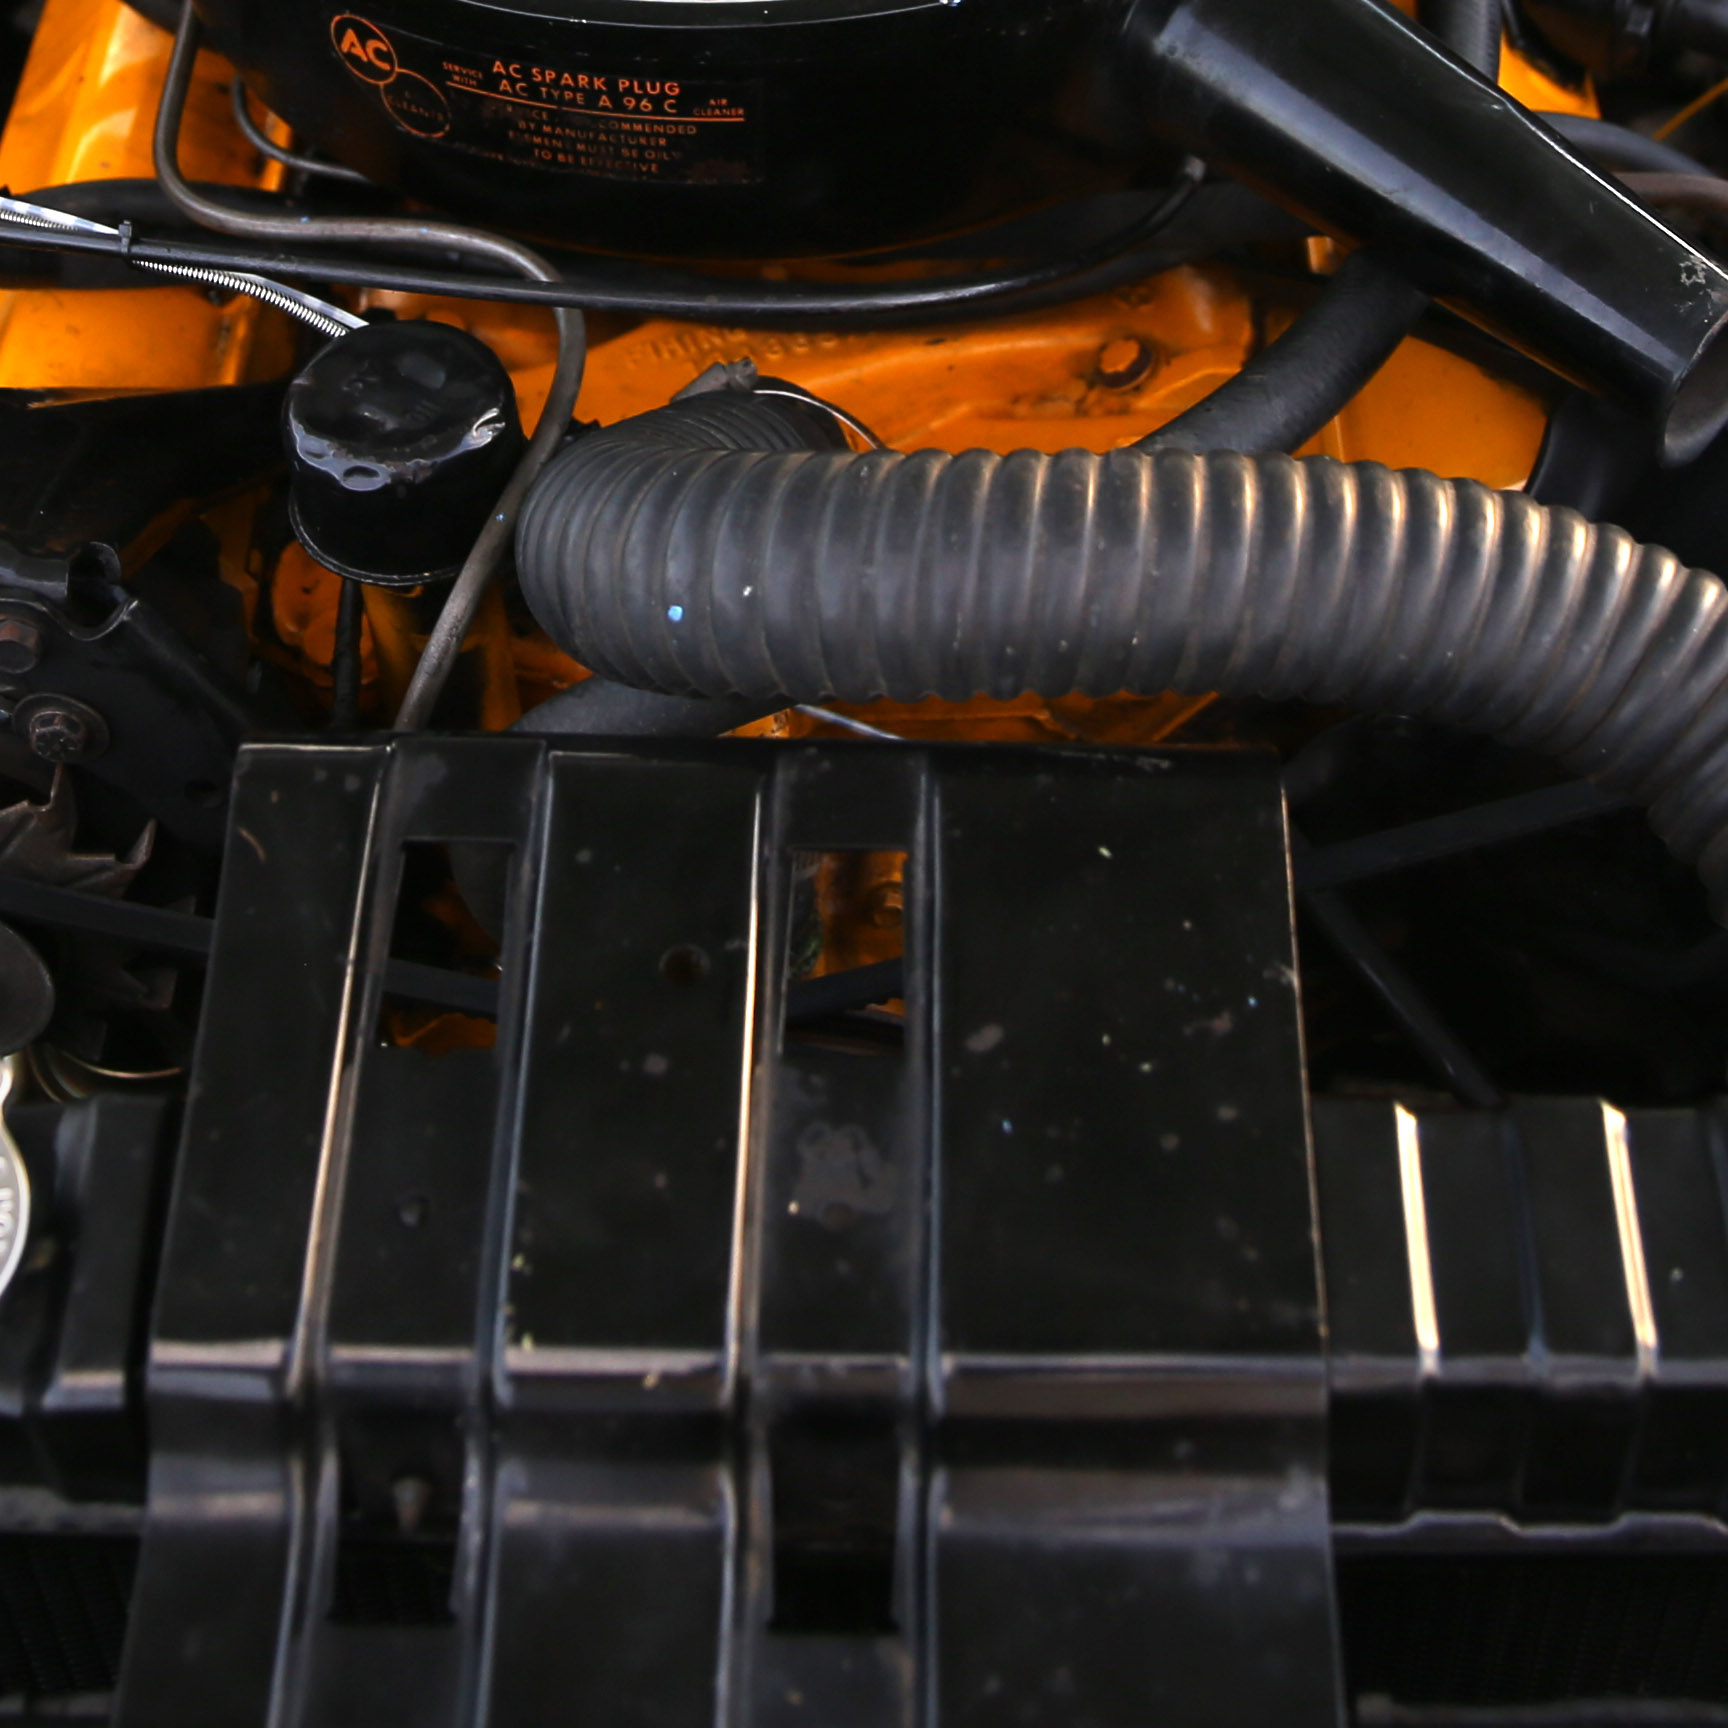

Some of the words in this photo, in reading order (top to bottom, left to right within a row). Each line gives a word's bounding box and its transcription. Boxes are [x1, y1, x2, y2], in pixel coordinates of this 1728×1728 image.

[341, 28, 392, 71] AC
[442, 61, 483, 80] SERVICE
[492, 60, 522, 78] AC
[531, 68, 608, 91] SPARK
[618, 79, 681, 96] PLUG
[452, 74, 477, 87] WITH
[499, 80, 529, 96] AC
[539, 87, 586, 105] TYPE
[598, 95, 613, 109] A
[622, 97, 653, 113] 96
[663, 99, 678, 114] C
[693, 107, 745, 117] CLEANER
[541, 124, 668, 147] MANUFACTURER
[534, 147, 553, 160] TO
[557, 152, 575, 164] BE
[621, 147, 639, 159] BE
